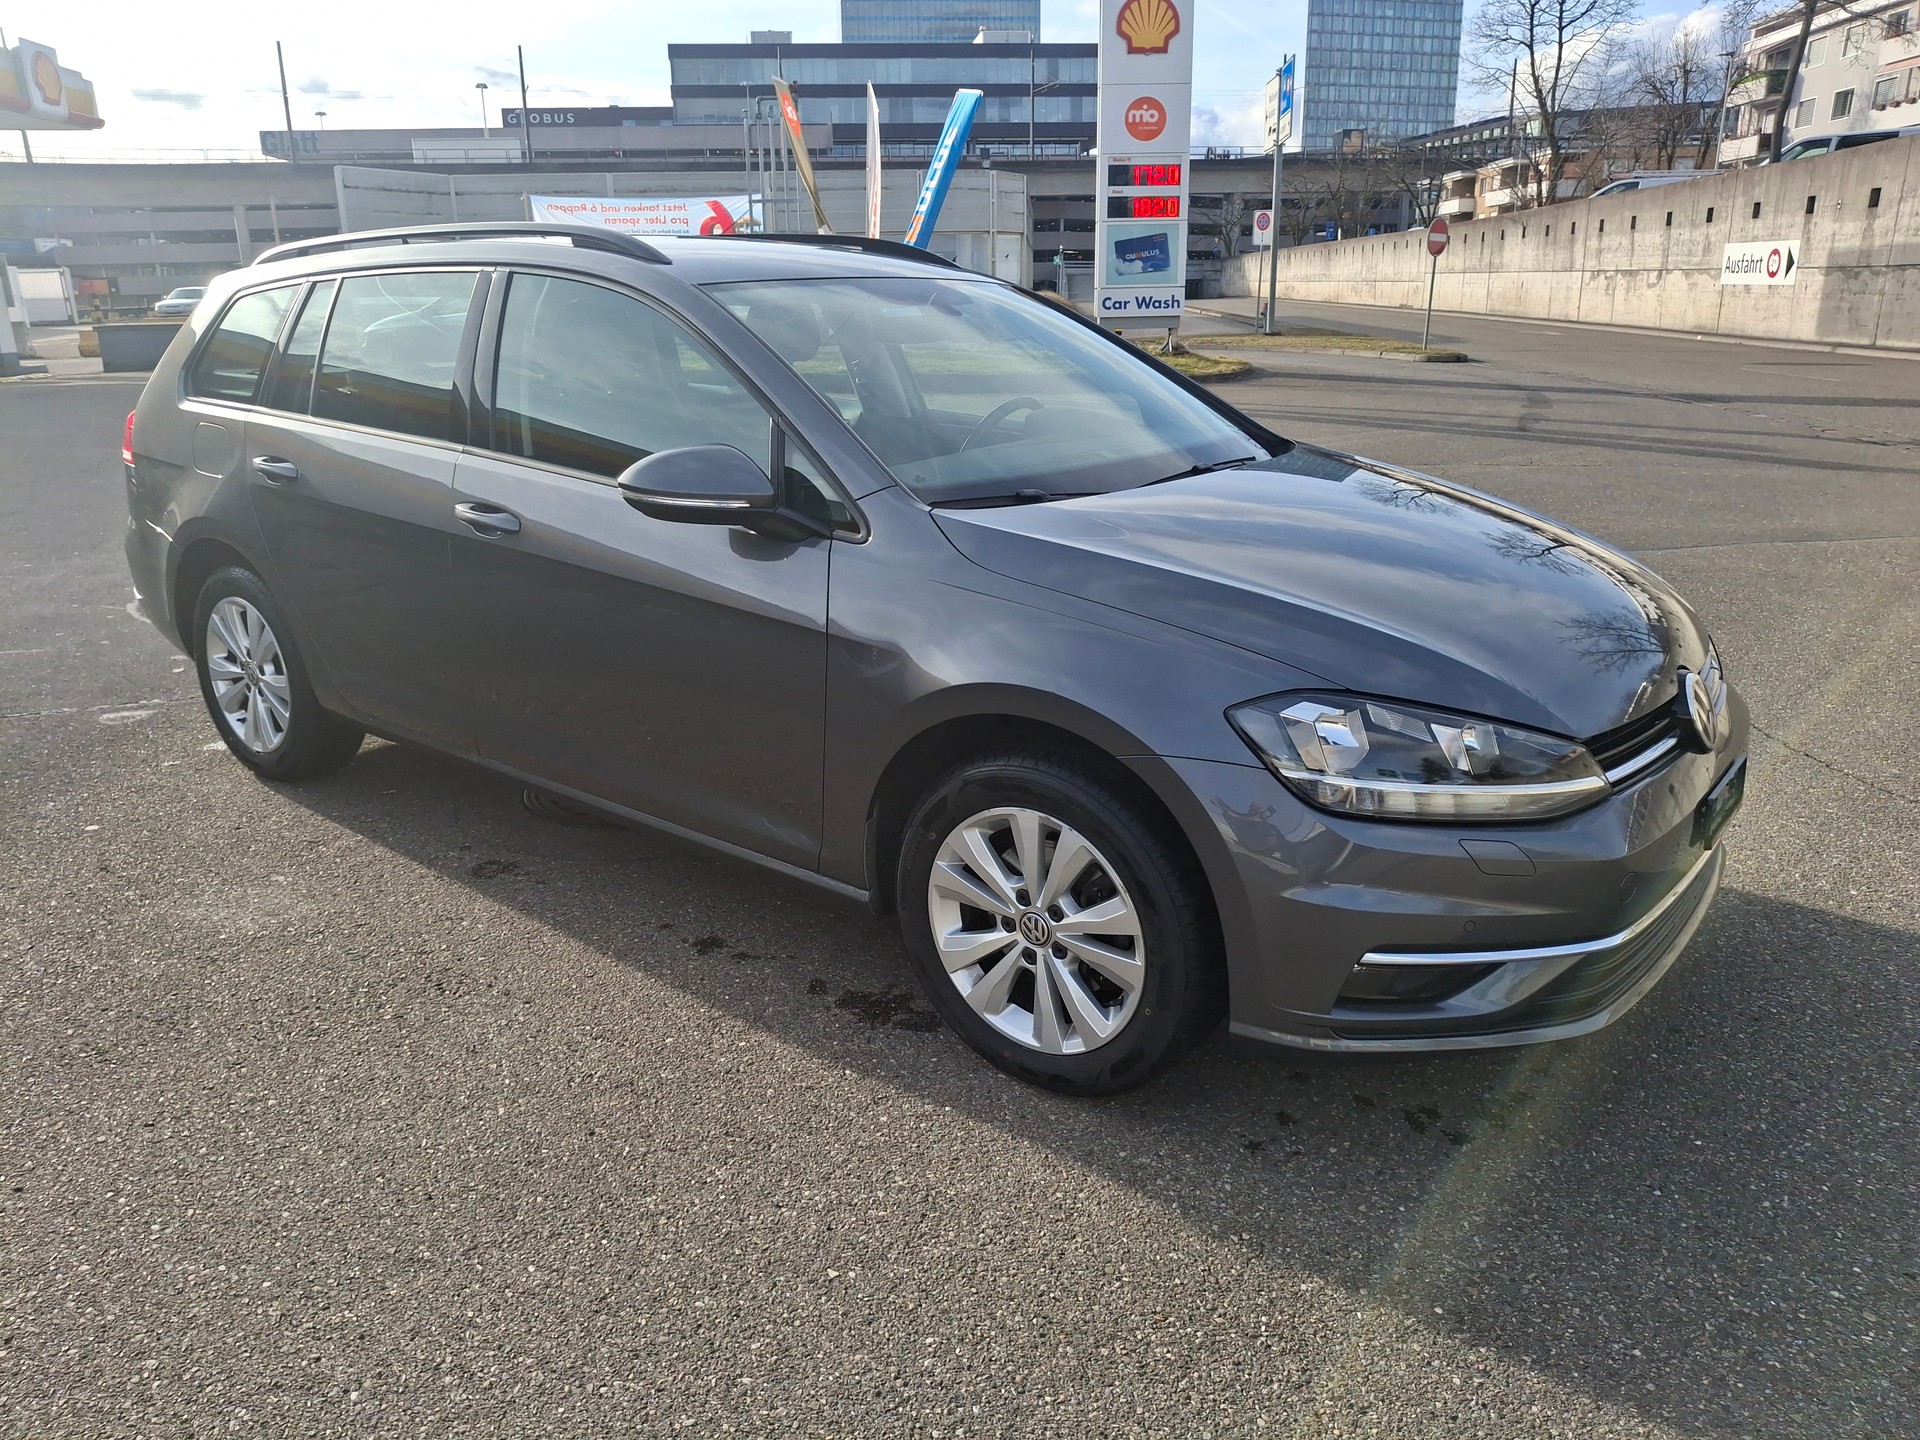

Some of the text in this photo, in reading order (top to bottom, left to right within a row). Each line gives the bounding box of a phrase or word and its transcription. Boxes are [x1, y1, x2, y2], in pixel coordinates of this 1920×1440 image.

[1128, 104, 1160, 123] mio
[1133, 165, 1180, 186] 172.0
[1133, 197, 1179, 218] 182.0
[1125, 248, 1160, 260] CUMULUS
[1724, 253, 1763, 273] Ausfahrt
[1101, 294, 1180, 310] Car Wash
